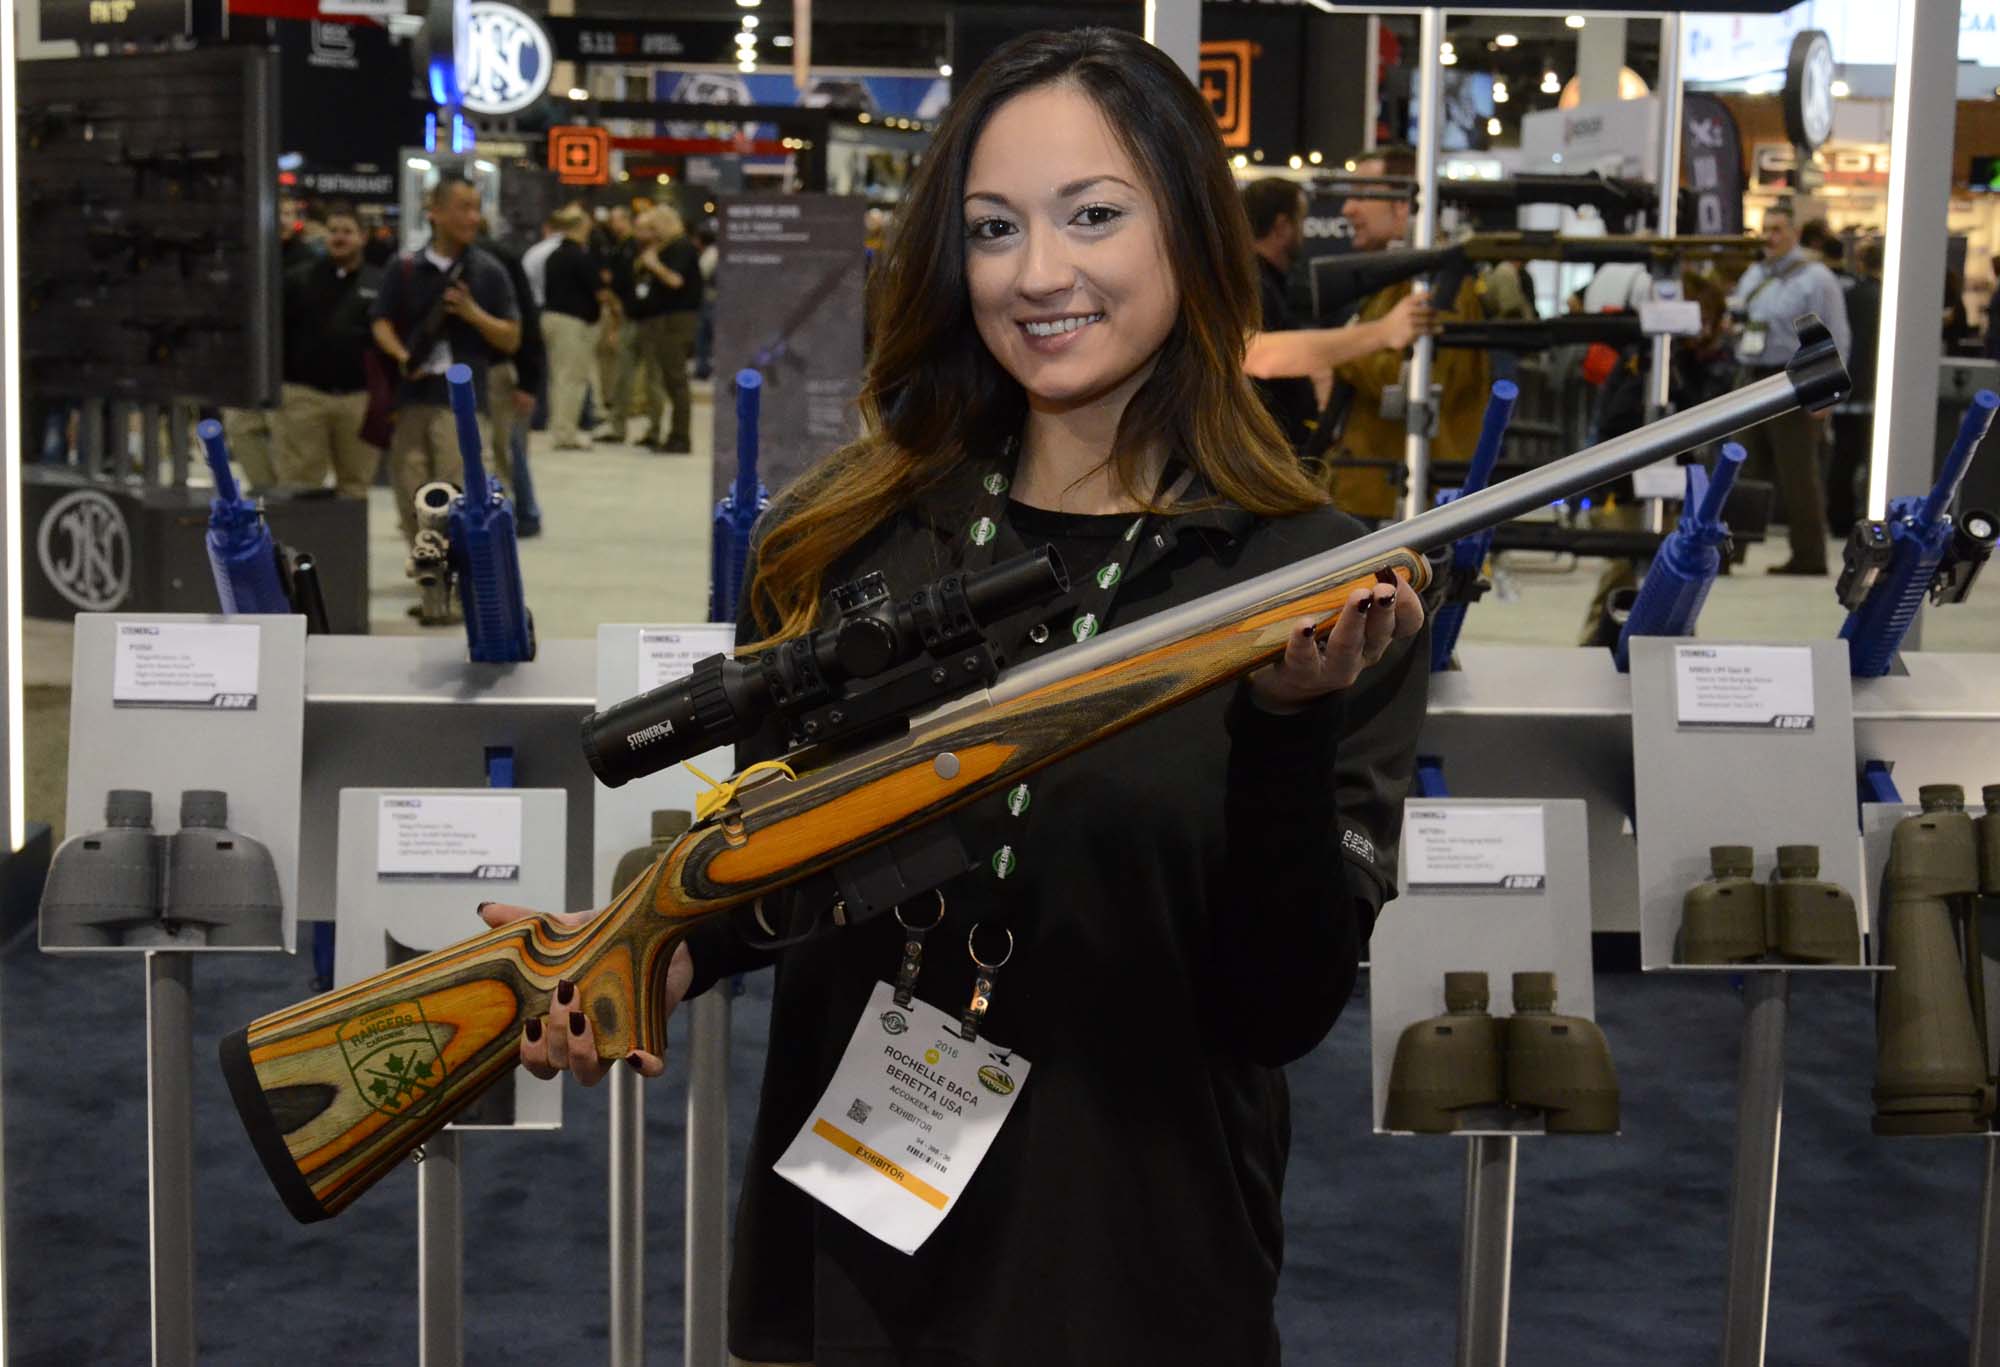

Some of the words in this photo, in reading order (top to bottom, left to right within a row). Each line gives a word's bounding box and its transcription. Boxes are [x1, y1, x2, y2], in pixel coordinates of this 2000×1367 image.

[627, 725, 661, 747] STEINER
[935, 1040, 959, 1058] 2016
[884, 1045, 946, 1087] ROCHELLE
[946, 1081, 978, 1107] BACA
[886, 1064, 937, 1102] BERETTA
[939, 1095, 963, 1117] USA
[889, 1102, 933, 1133] EXHIBITOR
[931, 1109, 944, 1121] MD
[856, 1146, 905, 1181] EXHIBITOR
